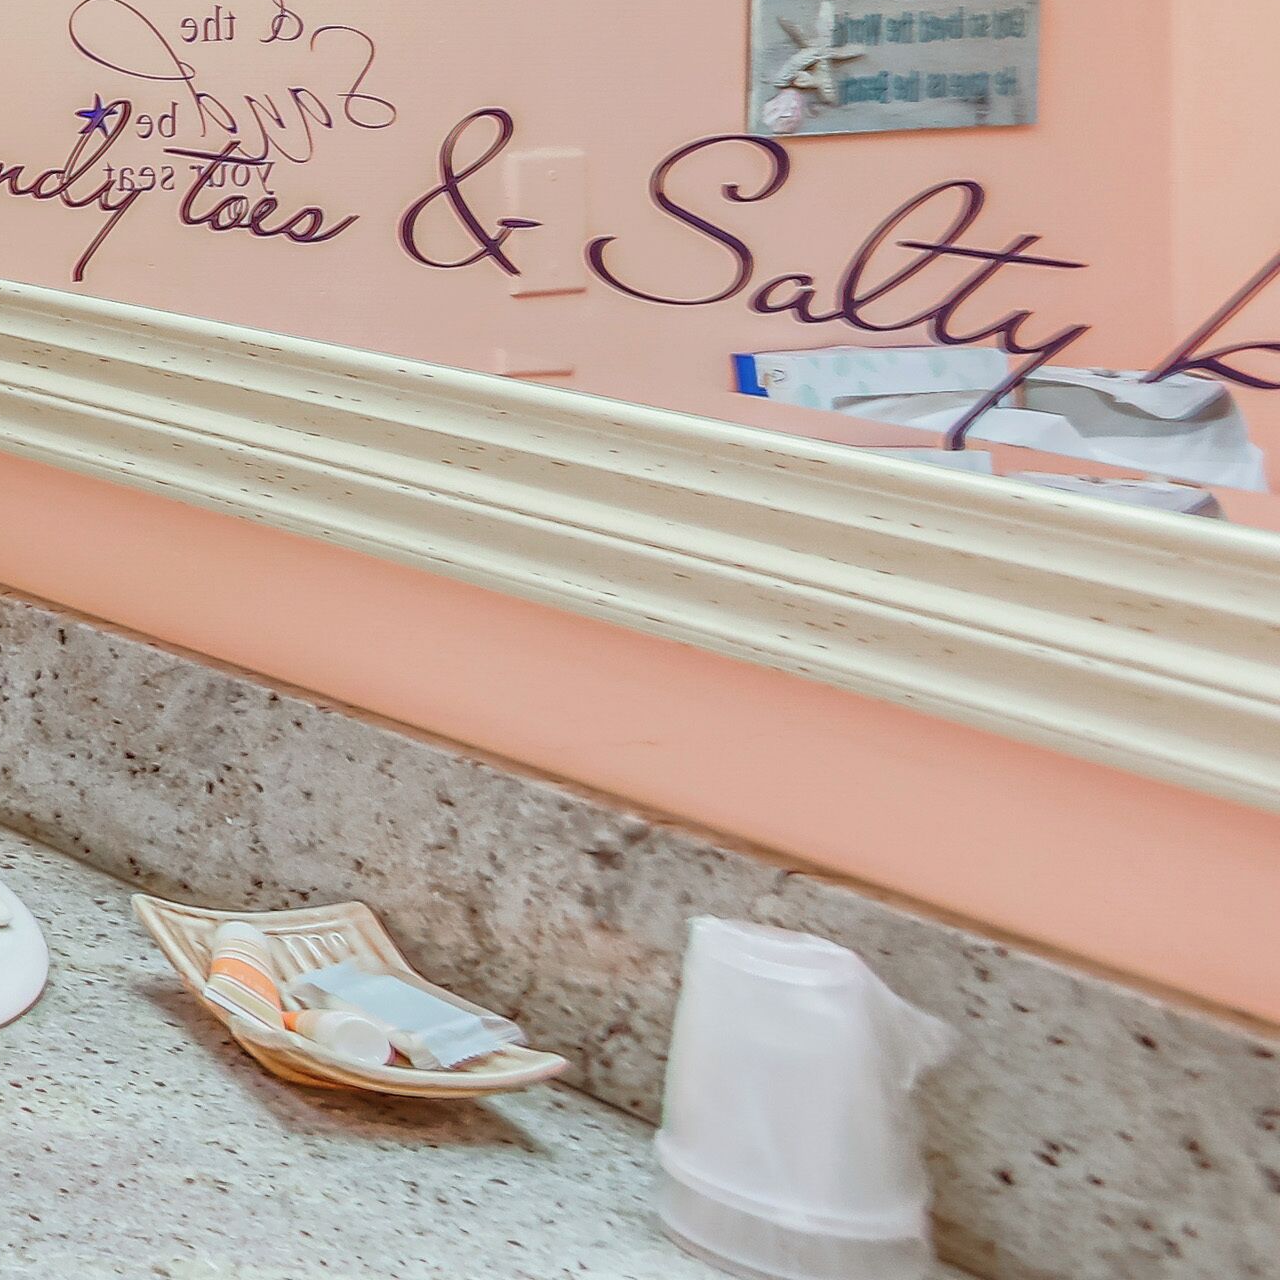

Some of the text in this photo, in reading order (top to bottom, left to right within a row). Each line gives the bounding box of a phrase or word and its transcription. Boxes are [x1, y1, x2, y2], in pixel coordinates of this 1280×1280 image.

[162, 140, 360, 245] toes
[397, 106, 543, 277] &
[584, 135, 1091, 452] Salty
